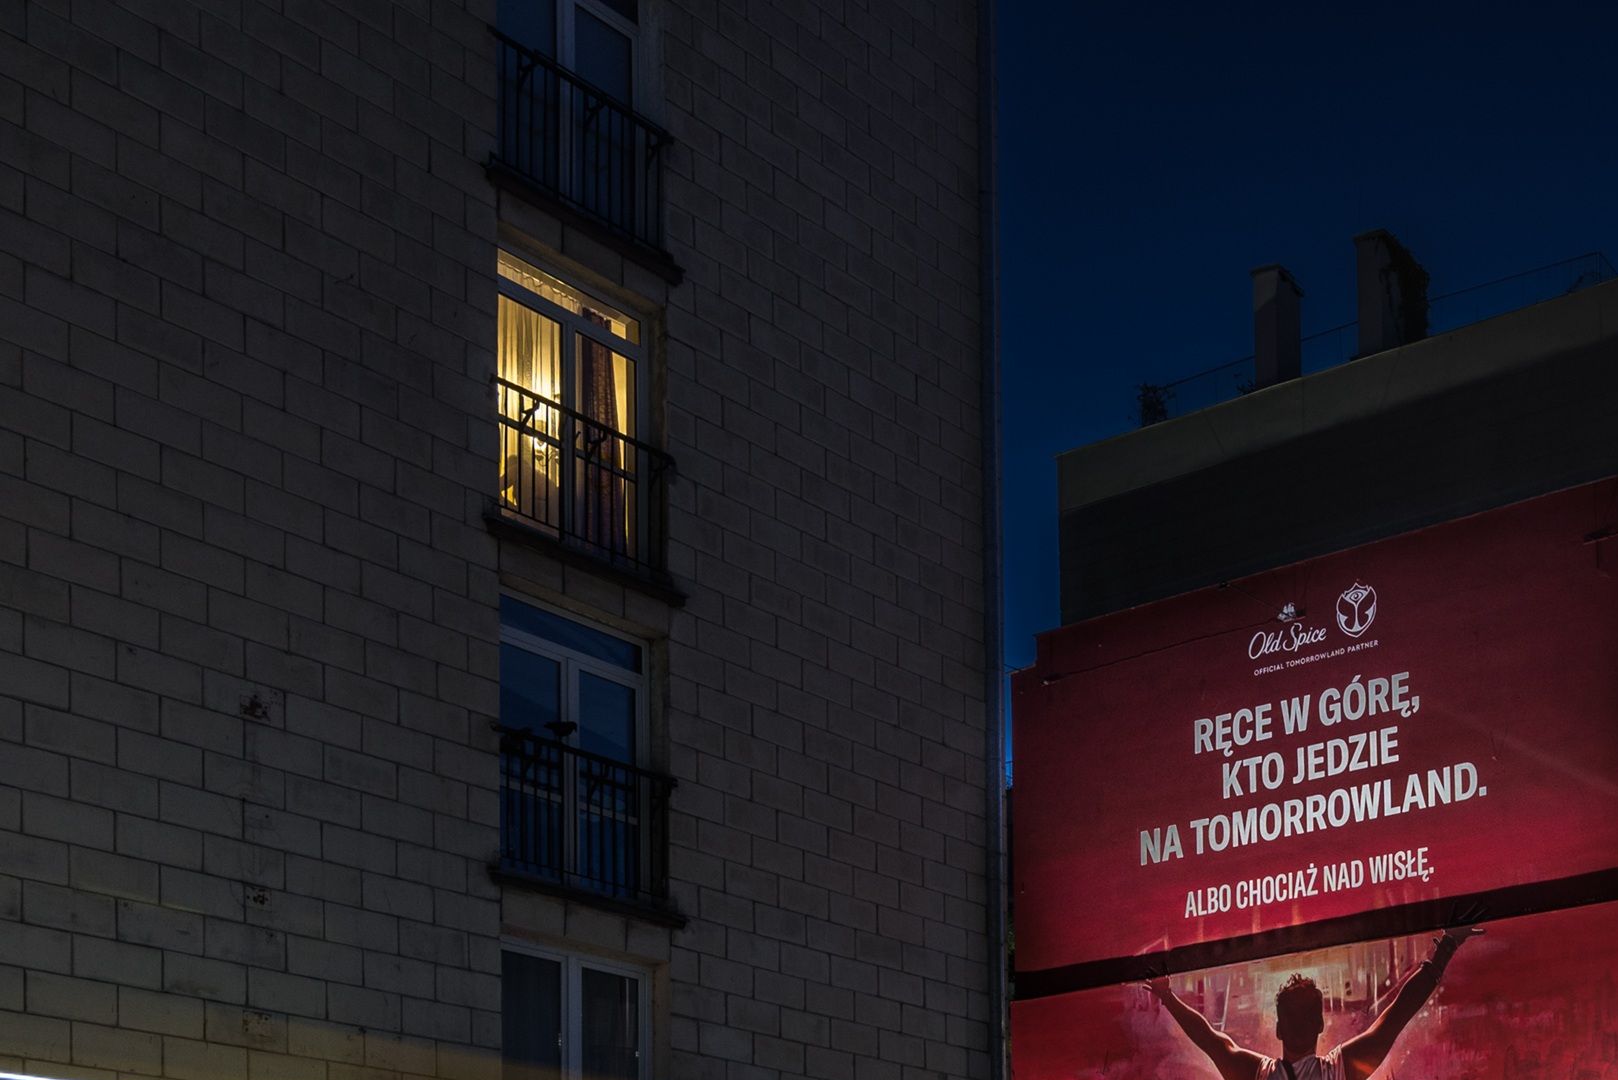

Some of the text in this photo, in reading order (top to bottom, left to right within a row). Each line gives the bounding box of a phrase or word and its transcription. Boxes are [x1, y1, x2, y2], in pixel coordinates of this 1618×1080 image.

[1248, 623, 1327, 659] Old Spice
[1253, 640, 1379, 676] OFFICIAL TOMORROWLAND PARTNER
[1194, 671, 1420, 757] RĘCE W GÓRĘ,
[1222, 726, 1400, 800] KTO JEDZIE
[1140, 761, 1488, 866] NA TOMORROWLAND.
[1184, 847, 1435, 918] ALBO CHOCIAŻ NAD WISŁĘ.
